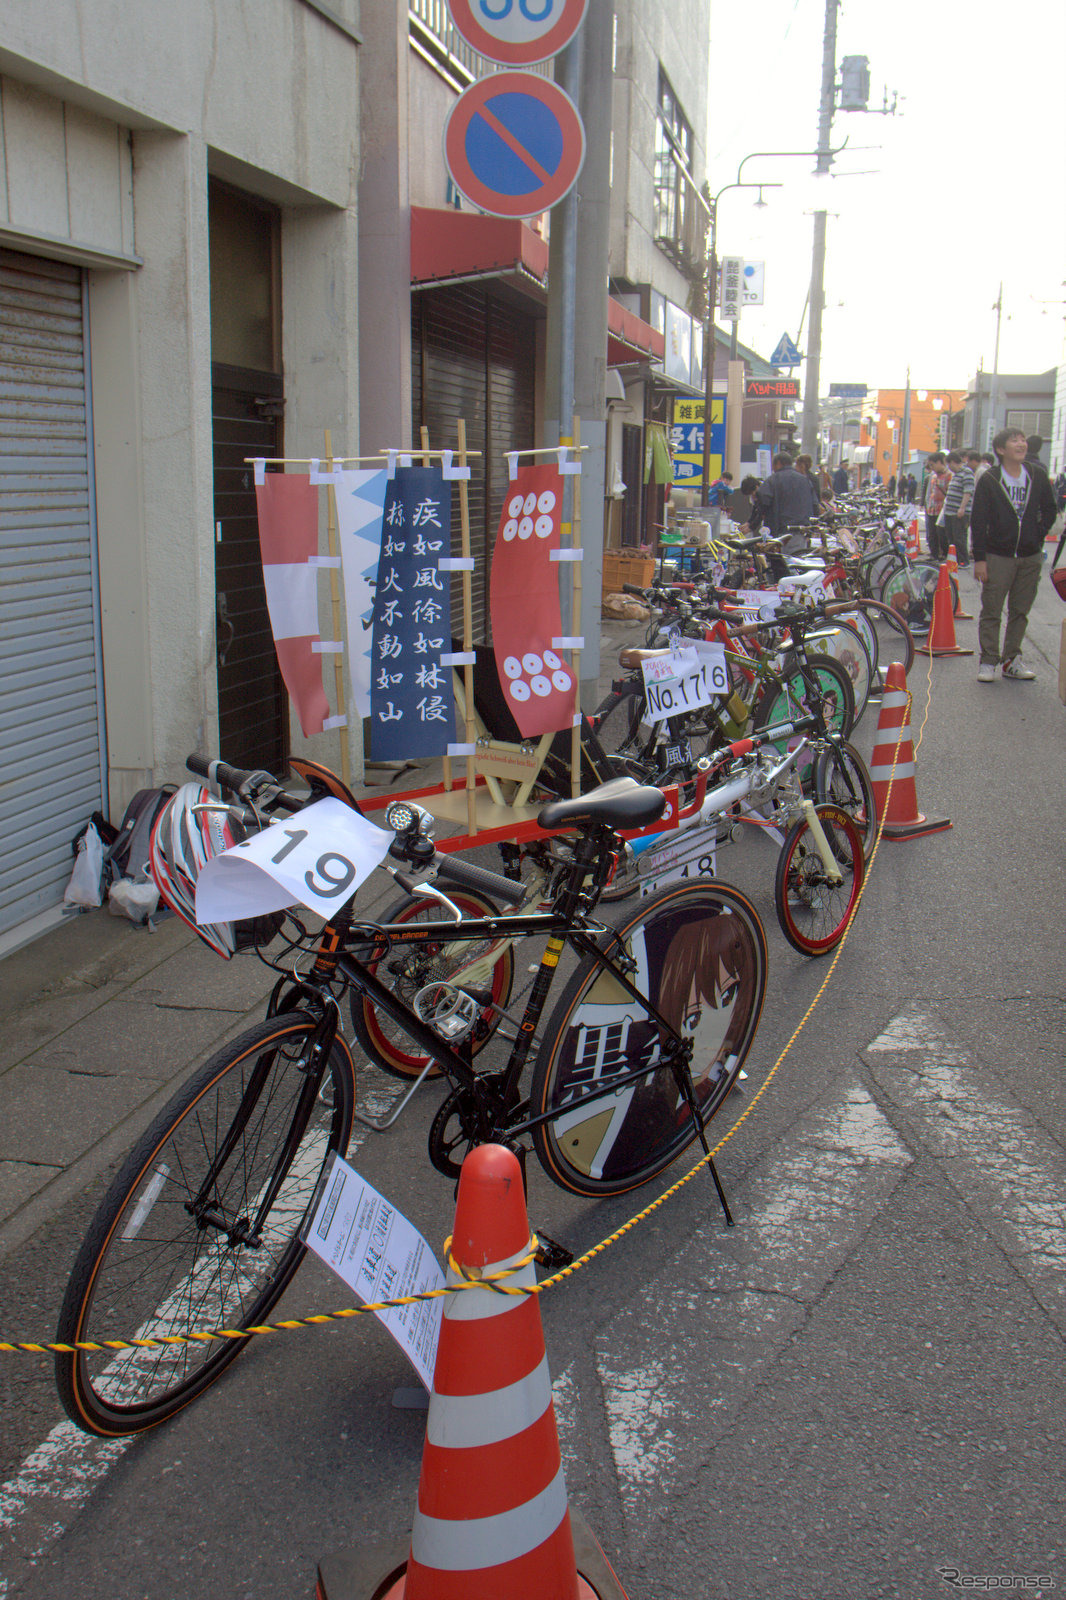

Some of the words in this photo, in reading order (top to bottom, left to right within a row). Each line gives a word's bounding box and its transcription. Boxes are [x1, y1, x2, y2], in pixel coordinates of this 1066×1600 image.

[410, 497, 448, 723] 疾如風徐如林侵
